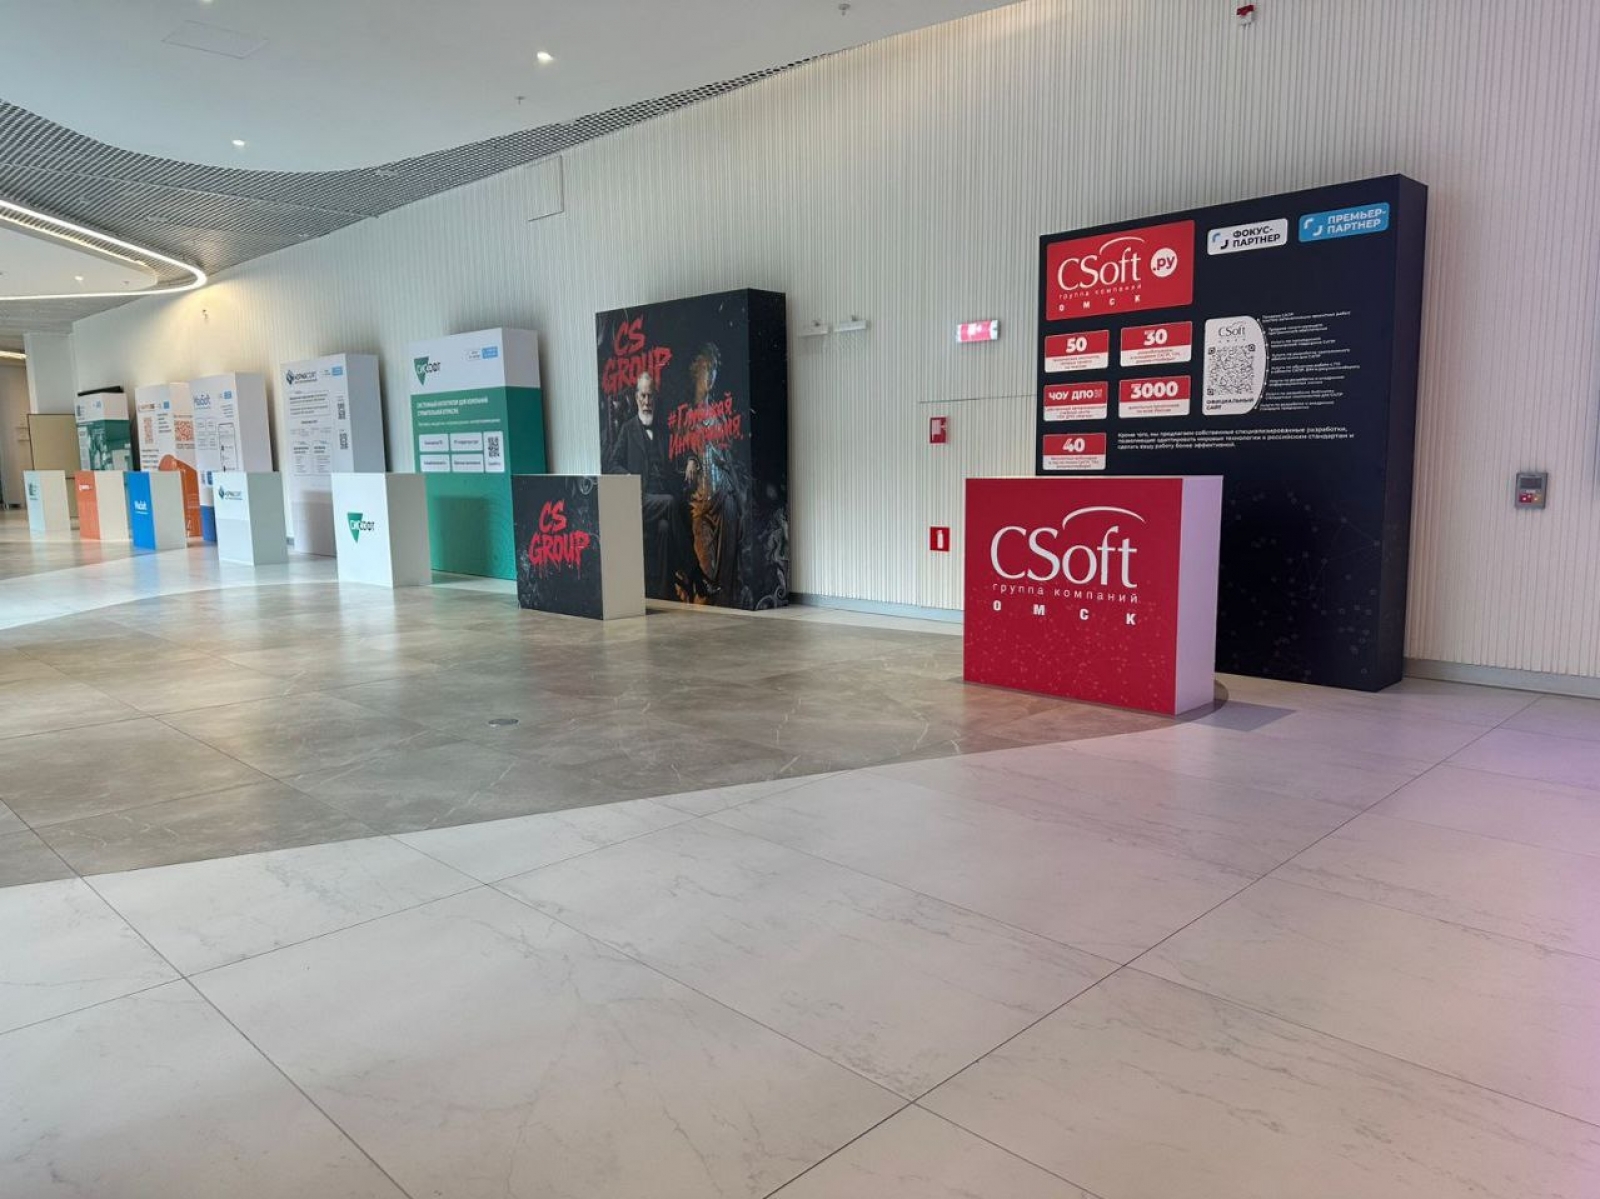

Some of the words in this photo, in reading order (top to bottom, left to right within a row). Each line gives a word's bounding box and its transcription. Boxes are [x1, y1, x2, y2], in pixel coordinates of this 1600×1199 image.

[1328, 206, 1387, 225] ПРЕМЬЕР-
[1232, 225, 1274, 239] ФОКУС-
[1327, 218, 1382, 235] ПАРТНЕР
[1232, 231, 1282, 248] ПАРТНЕР
[1057, 246, 1142, 291] CSoft
[615, 318, 646, 355] CS
[1065, 337, 1088, 354] 50
[1143, 328, 1168, 346] 30
[602, 346, 674, 397] GROUP
[1048, 391, 1069, 401] ЧОУ
[1071, 389, 1094, 401] ДПО
[1130, 381, 1179, 399] 3000
[1062, 438, 1086, 453] 40
[539, 501, 567, 530] CS
[528, 530, 591, 569] GROUP
[990, 524, 1138, 589] CSoft
[992, 582, 1045, 596] группа
[1053, 588, 1139, 604] компаний
